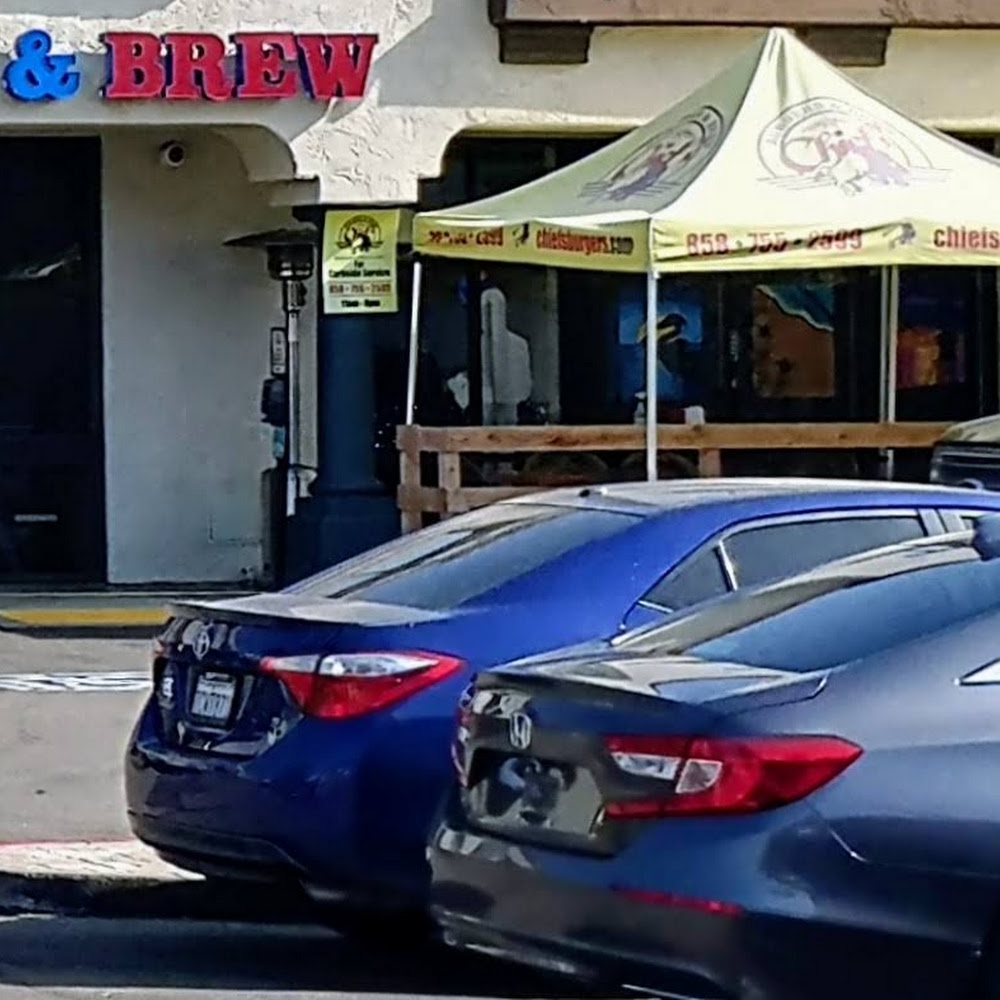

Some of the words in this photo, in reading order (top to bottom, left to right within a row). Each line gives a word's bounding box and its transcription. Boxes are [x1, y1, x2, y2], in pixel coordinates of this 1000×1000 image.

[4, 29, 80, 100] &
[101, 31, 378, 99] BREW
[686, 233, 728, 256] 858
